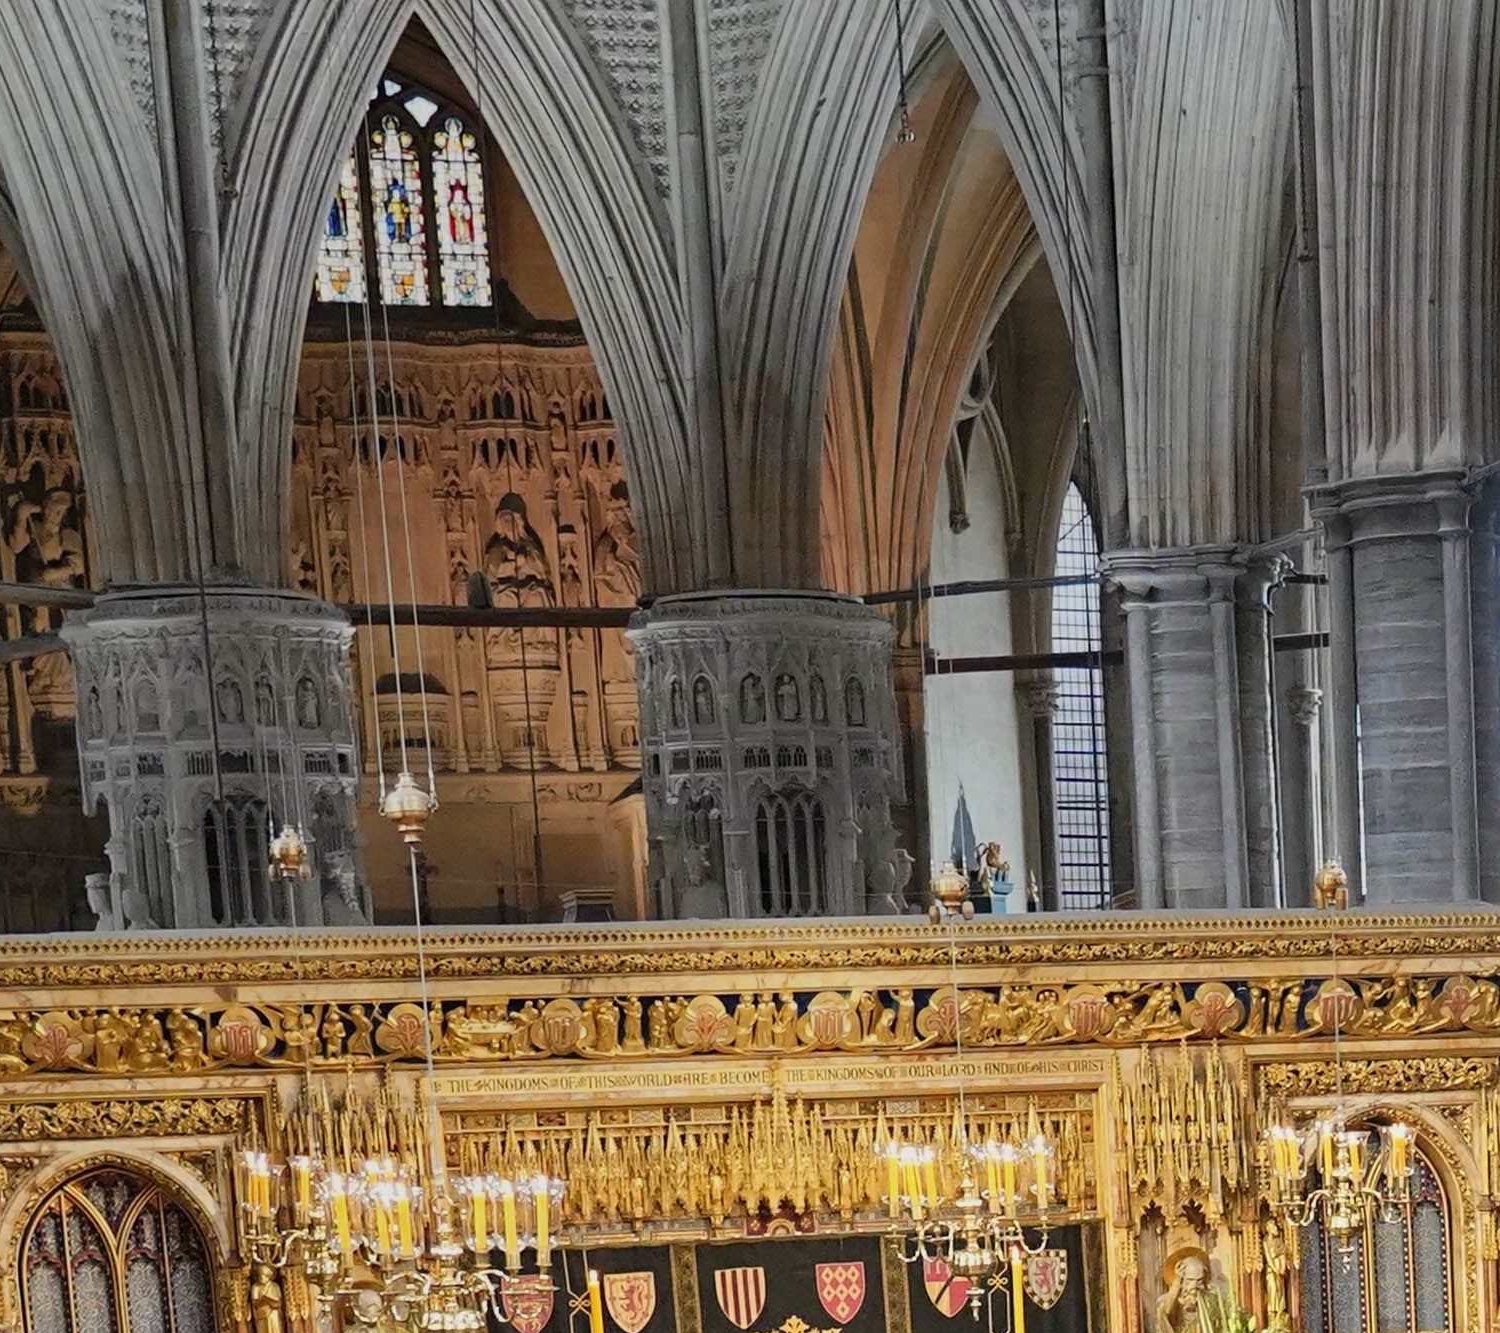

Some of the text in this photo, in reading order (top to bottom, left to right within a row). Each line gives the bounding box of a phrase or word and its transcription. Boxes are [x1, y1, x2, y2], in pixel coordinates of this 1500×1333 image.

[450, 1058, 1107, 1094] THE KINGDOMS OF THIS WORLD ARE BECOME THE KINGDOMS OF OUR LORD AND OF HIS CHRIST
